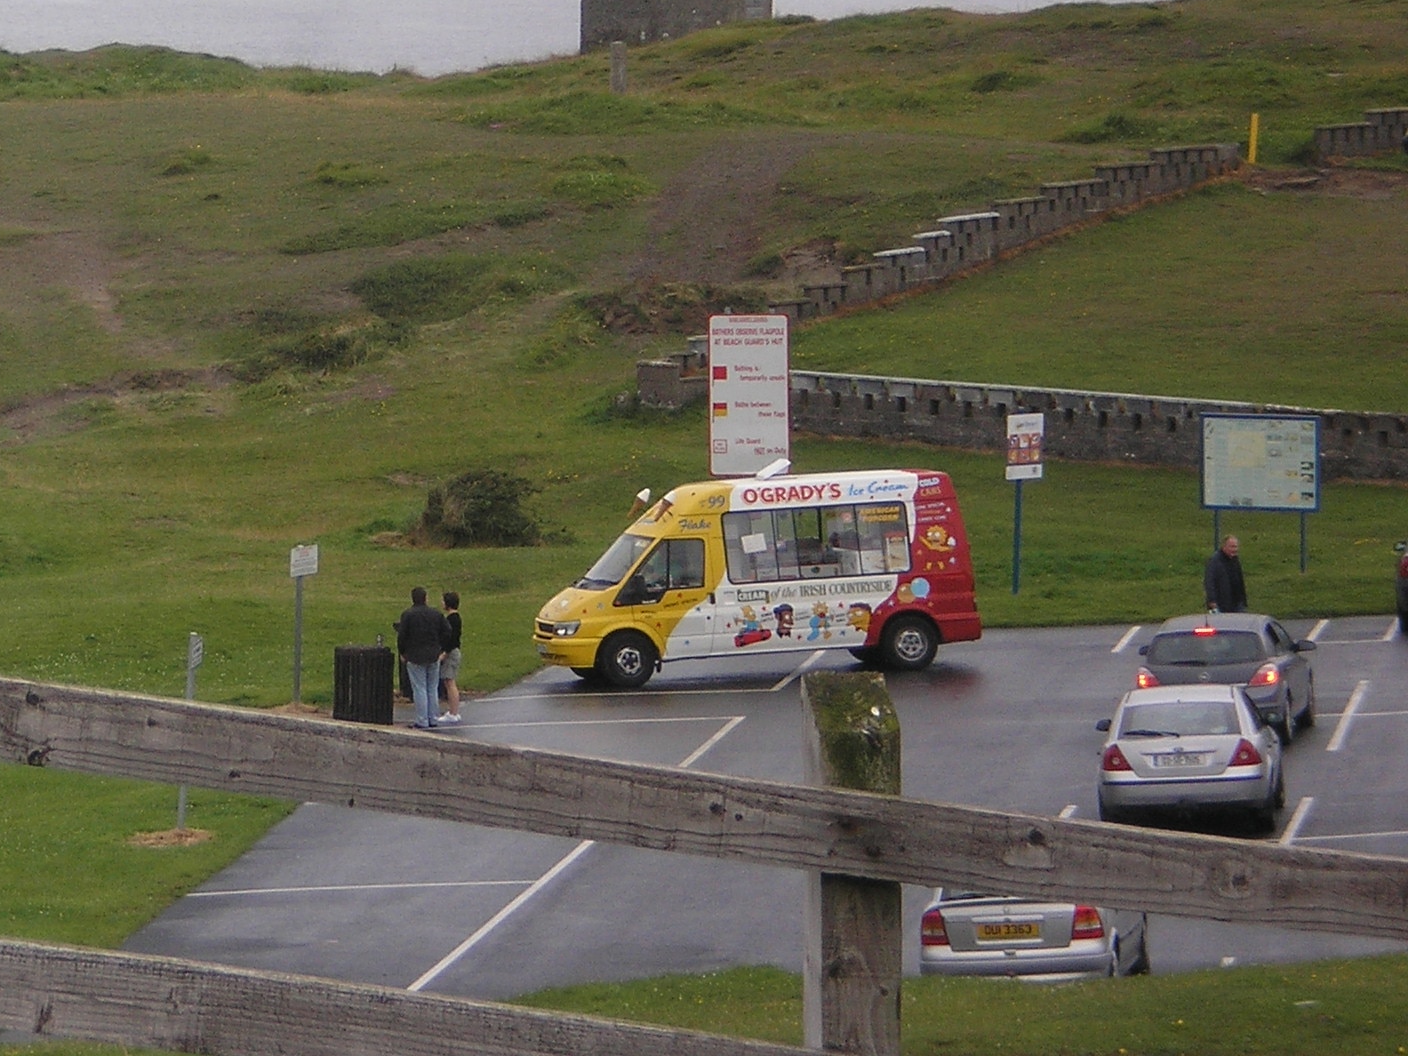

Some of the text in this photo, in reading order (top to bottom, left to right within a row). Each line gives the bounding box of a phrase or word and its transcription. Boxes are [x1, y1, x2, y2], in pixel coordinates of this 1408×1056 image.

[743, 481, 908, 504] O'GRADY'S Ice Cream
[738, 590, 767, 601] CREAM
[771, 587, 781, 599] of
[781, 586, 797, 597] the
[799, 584, 827, 597] IRISH
[828, 580, 892, 596] COUNTRYSIDE
